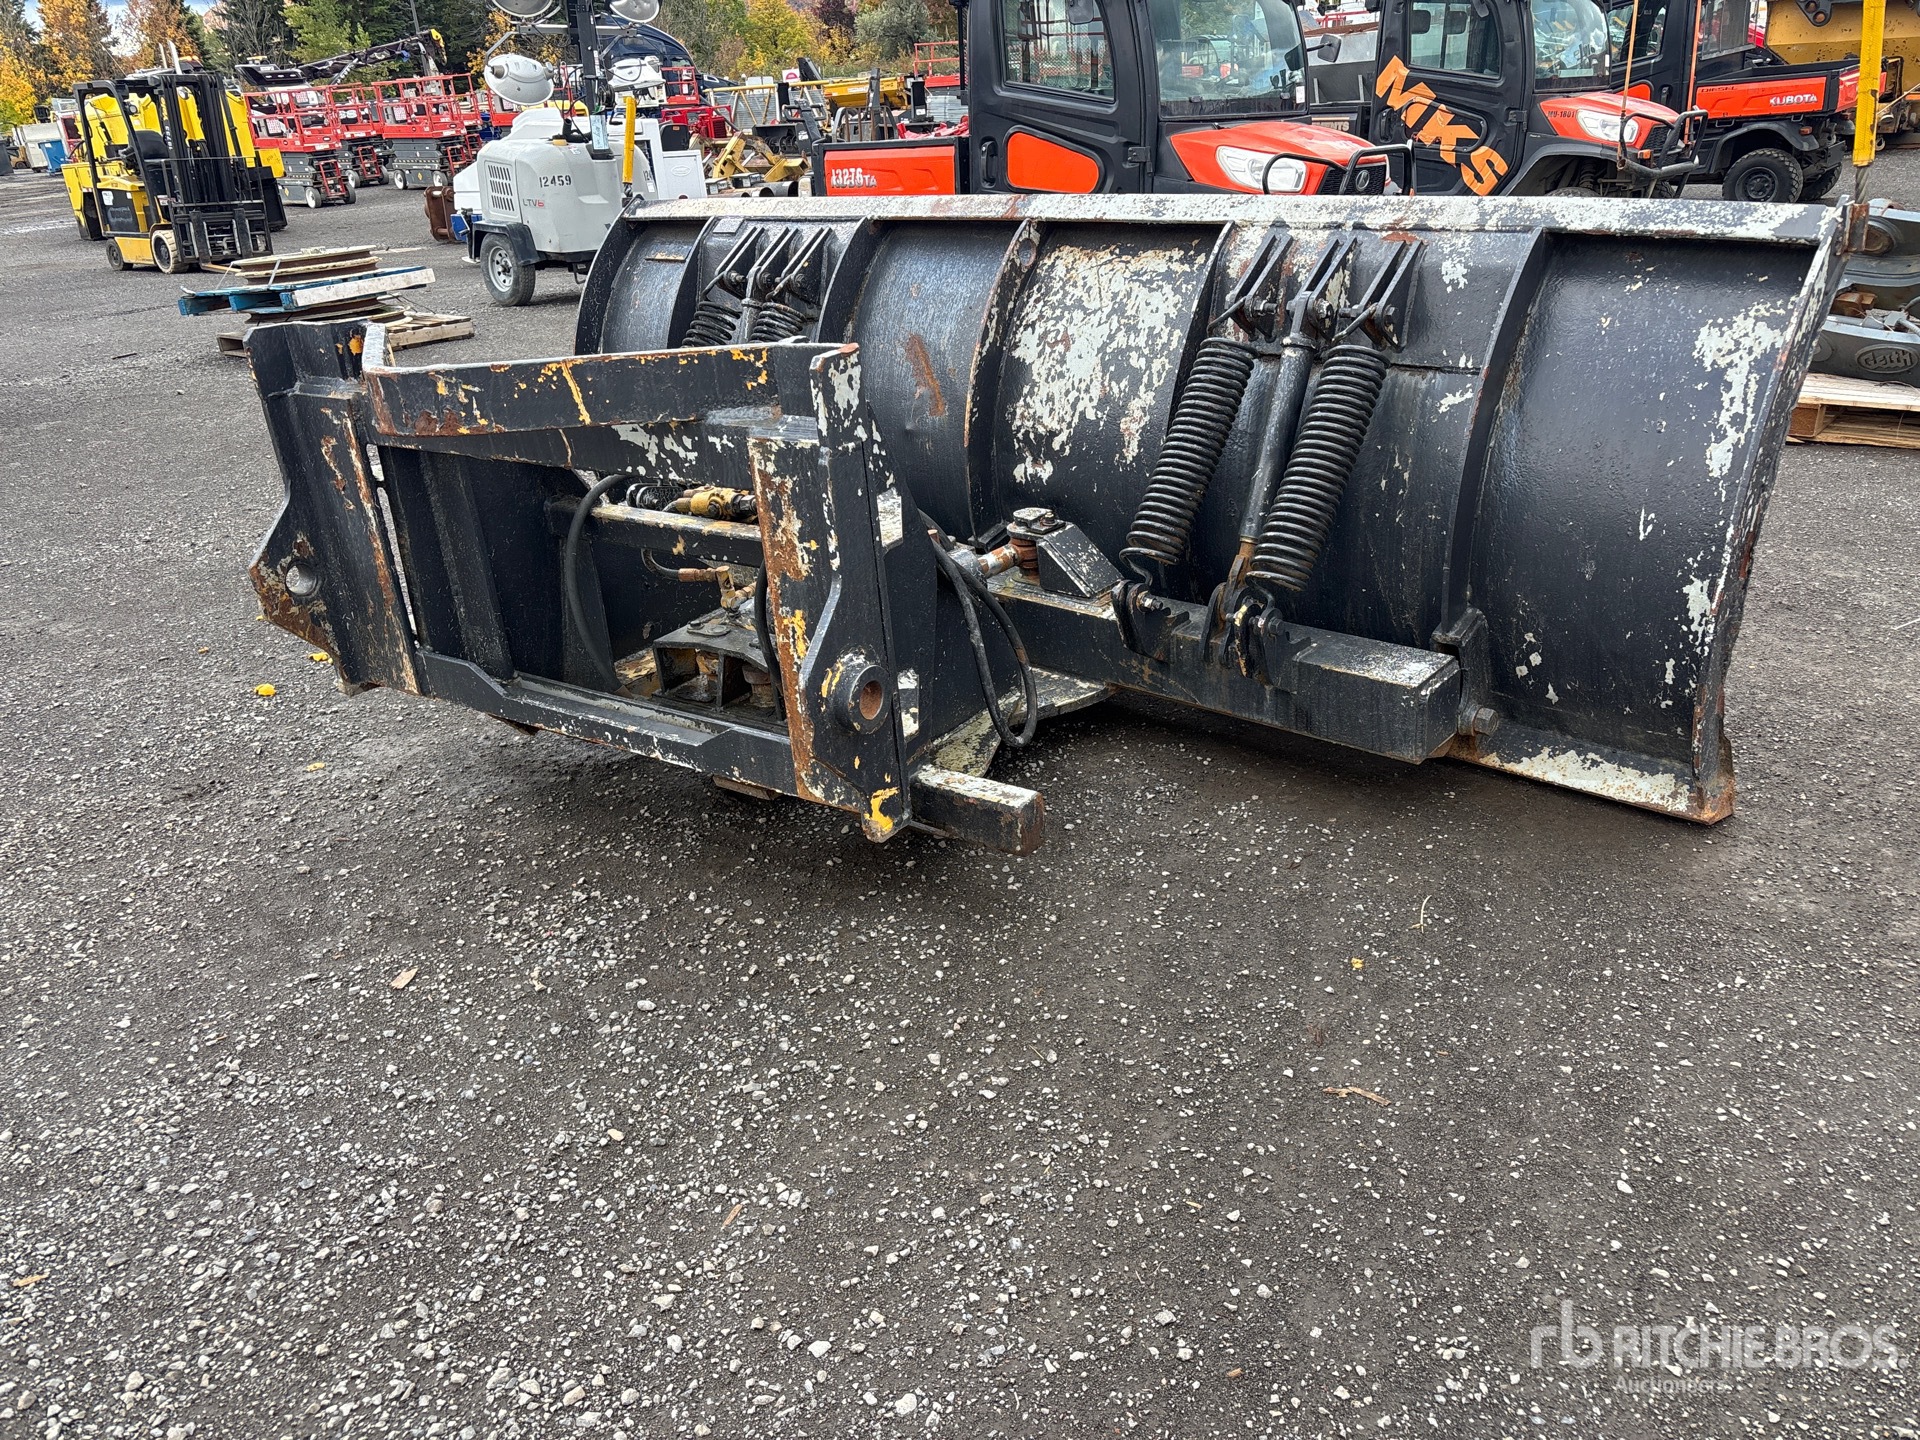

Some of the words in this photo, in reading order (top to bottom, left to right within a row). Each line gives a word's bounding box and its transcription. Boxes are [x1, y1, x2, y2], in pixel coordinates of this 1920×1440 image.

[1769, 94, 1818, 106] KUBOTA
[1548, 110, 1575, 118] MU-1801
[1376, 55, 1508, 196] MKS
[539, 174, 572, 188] 12459
